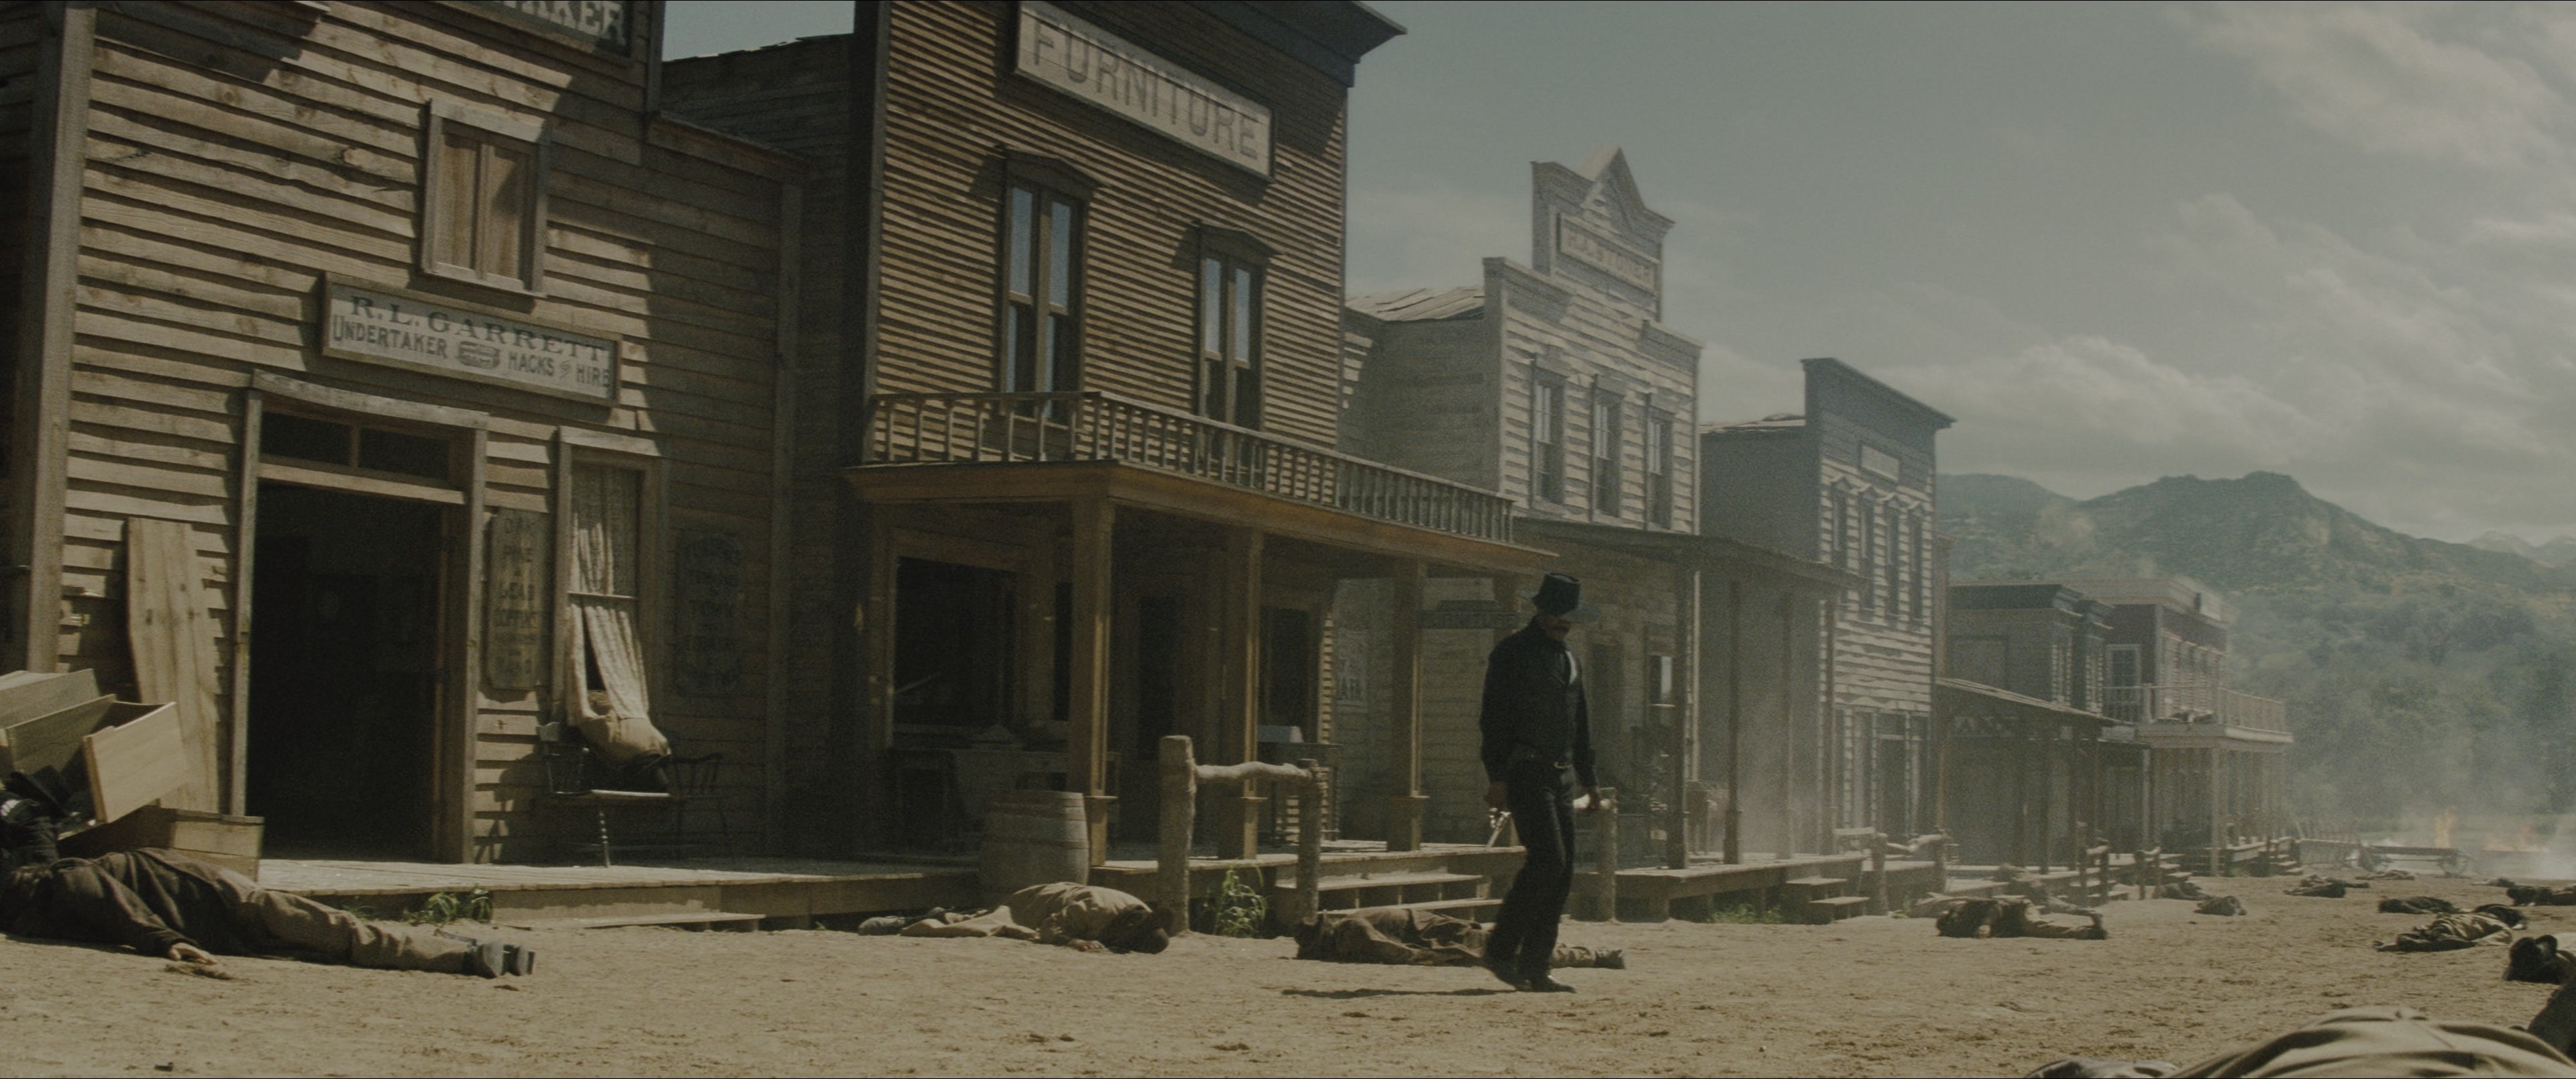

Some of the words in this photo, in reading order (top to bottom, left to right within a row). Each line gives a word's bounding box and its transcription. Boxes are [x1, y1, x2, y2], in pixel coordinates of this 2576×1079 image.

[502, 1, 626, 46] KER
[1034, 9, 1258, 160] FURNITURE
[333, 313, 449, 358] UNDERTAKER
[507, 351, 555, 378] HACKS
[576, 363, 611, 389] HIRE
[427, 311, 606, 362] GARRETT
